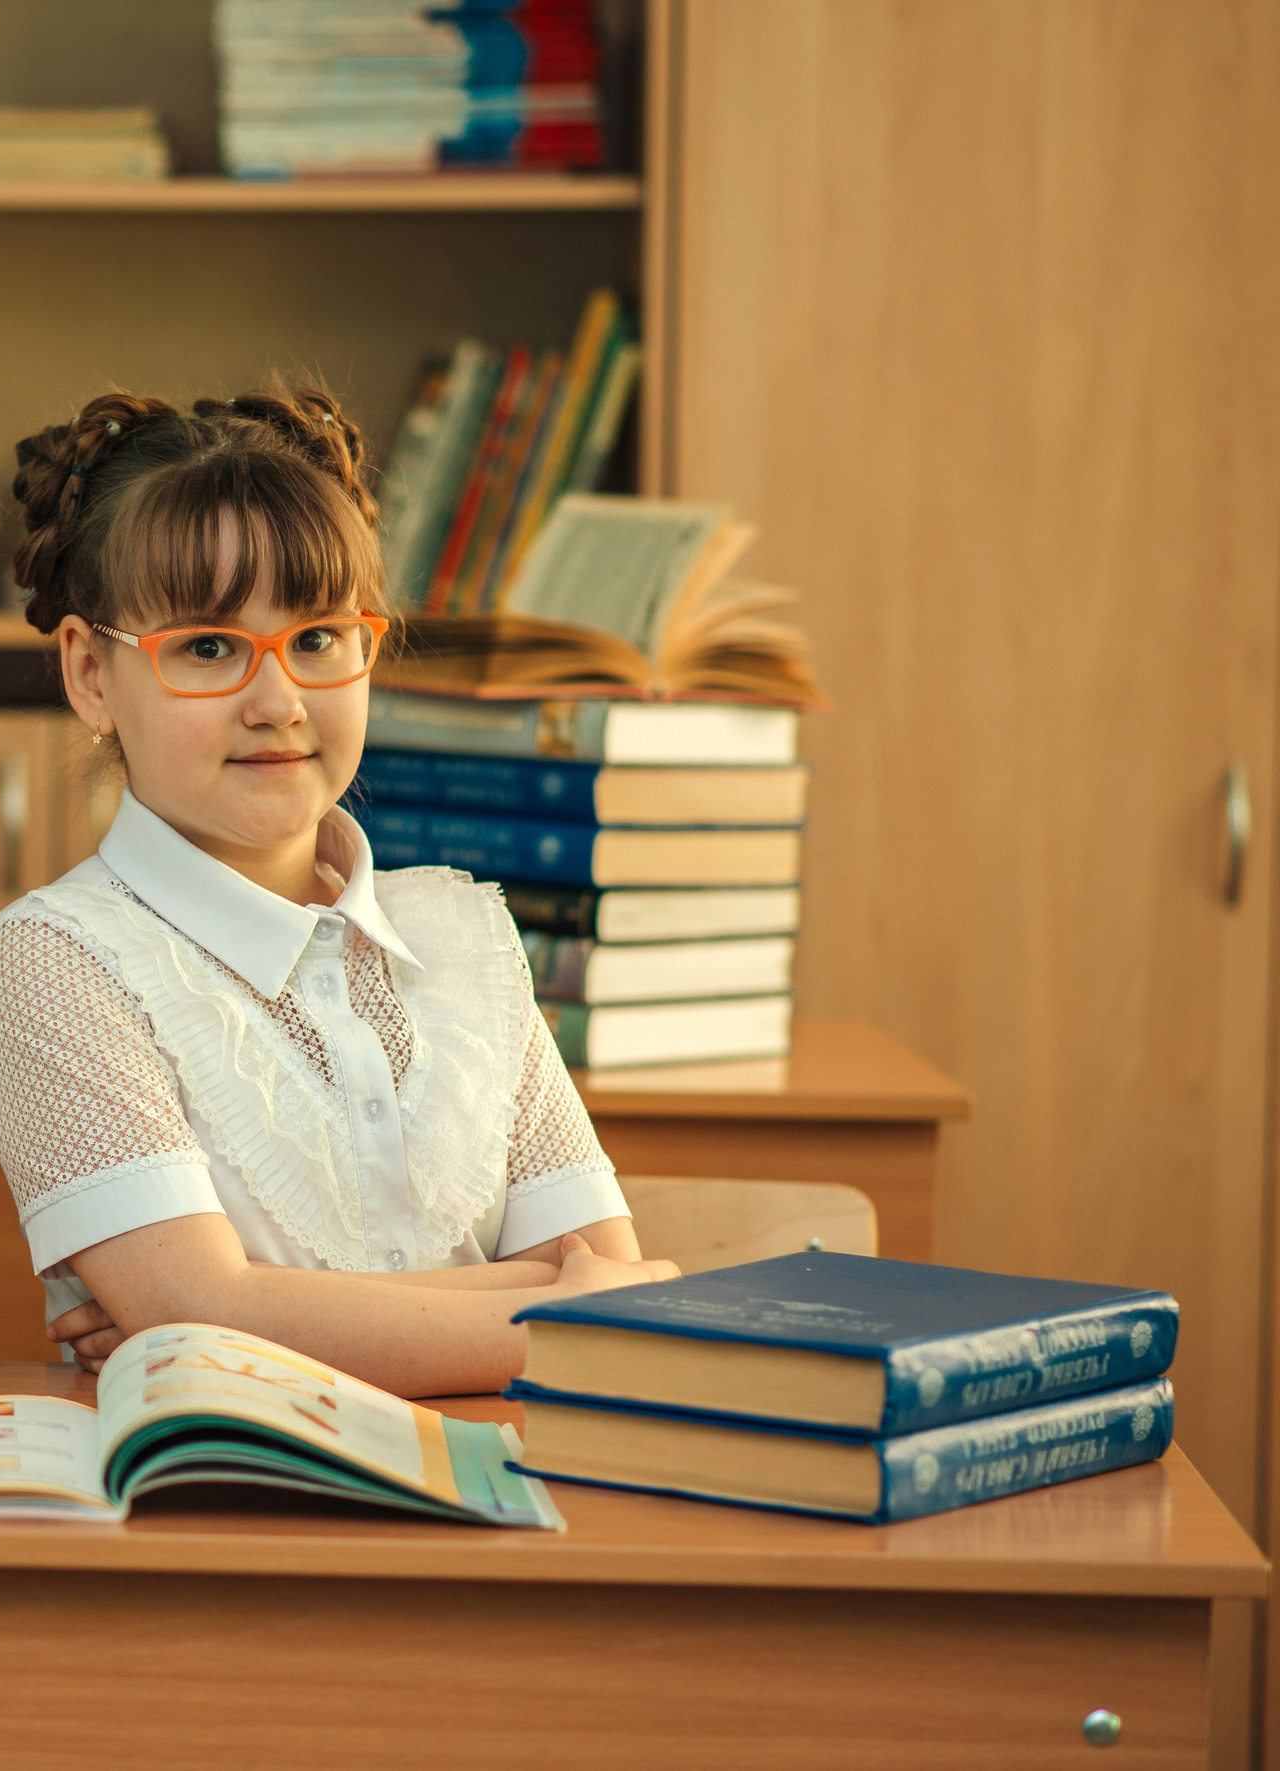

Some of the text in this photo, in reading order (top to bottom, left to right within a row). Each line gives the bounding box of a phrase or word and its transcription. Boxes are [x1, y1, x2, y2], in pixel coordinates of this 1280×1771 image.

[961, 1352, 1111, 1408] УЧЕБНЫЙ СЛОВАРЬ
[1026, 1410, 1107, 1445] РУССКОГО
[955, 1435, 1110, 1492] УЧЕБНЫЙ СЛОВАРЬ
